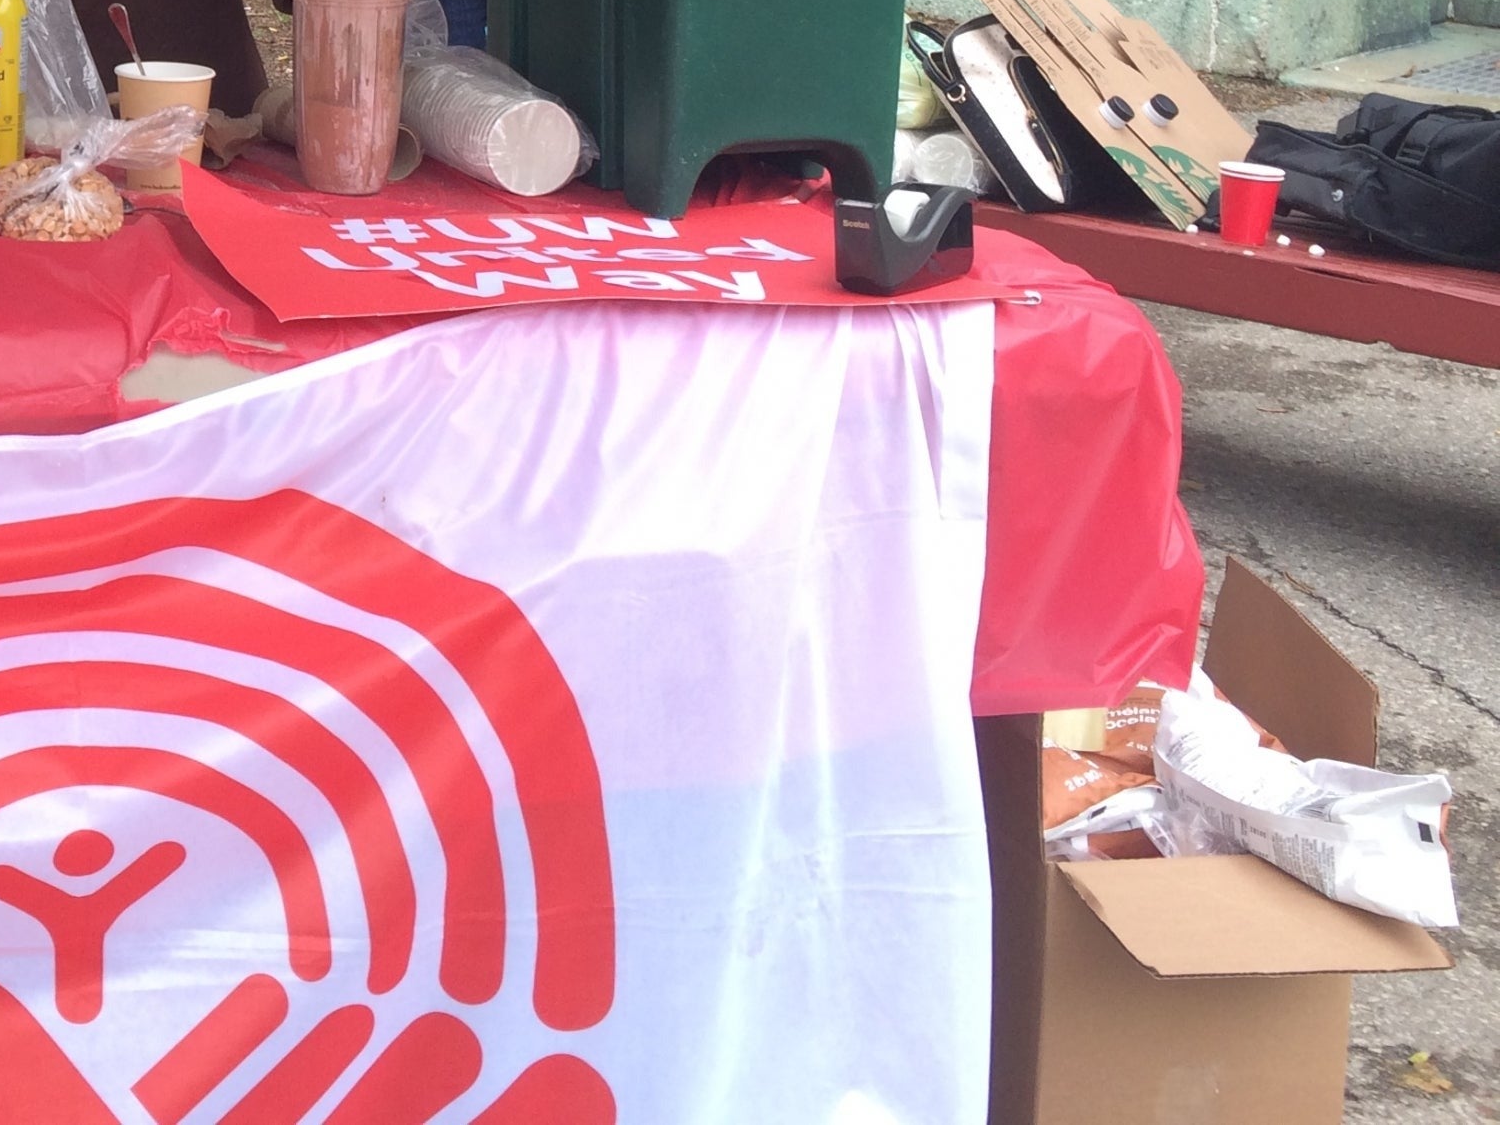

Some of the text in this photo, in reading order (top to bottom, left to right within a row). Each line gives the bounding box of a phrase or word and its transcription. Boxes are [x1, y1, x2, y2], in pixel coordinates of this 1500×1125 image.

[330, 216, 680, 243] #UW
[300, 237, 815, 271] United
[408, 265, 766, 301] Way
